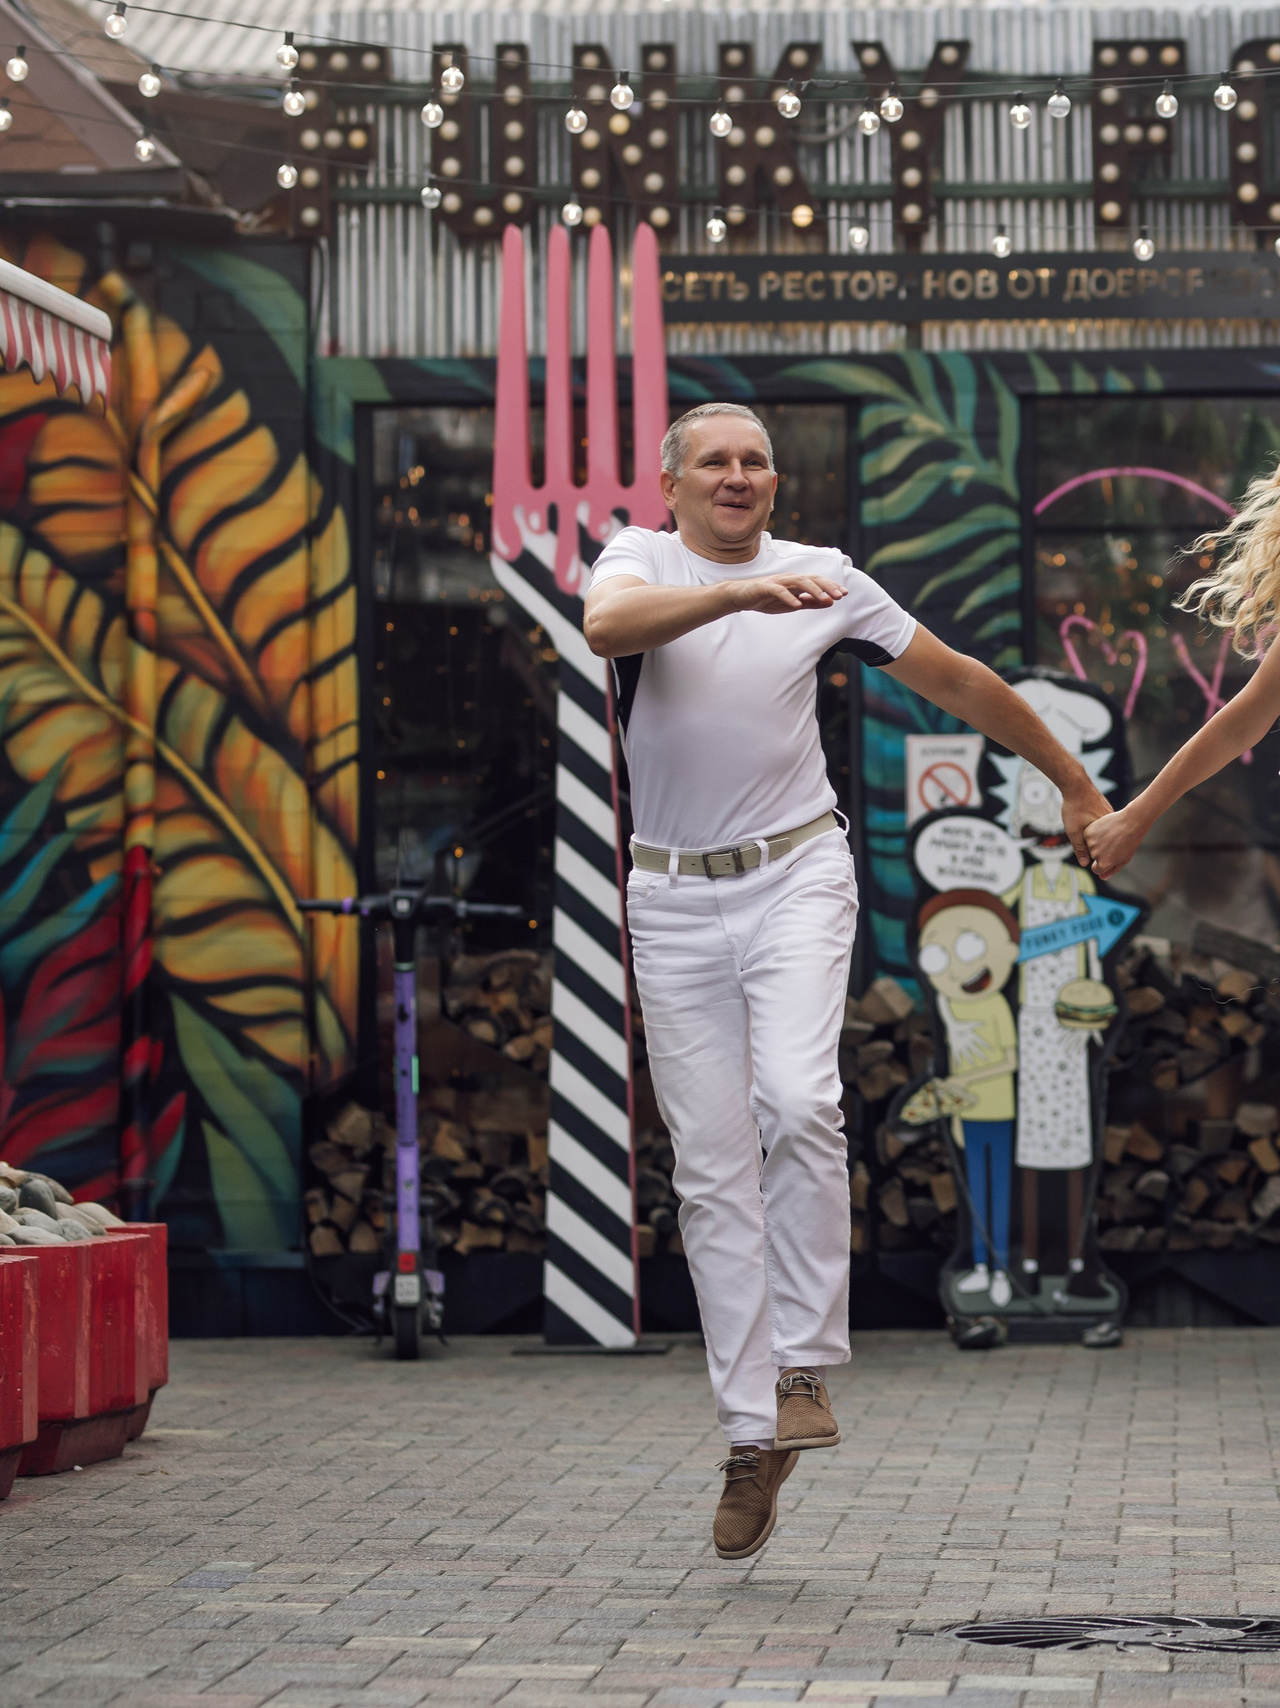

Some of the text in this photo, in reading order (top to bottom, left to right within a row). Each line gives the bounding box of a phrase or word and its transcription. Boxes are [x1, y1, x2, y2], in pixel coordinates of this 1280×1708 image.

[292, 40, 971, 245] FUNKY
[661, 269, 750, 301] СЕТЬ
[1006, 266, 1056, 300] ОТ
